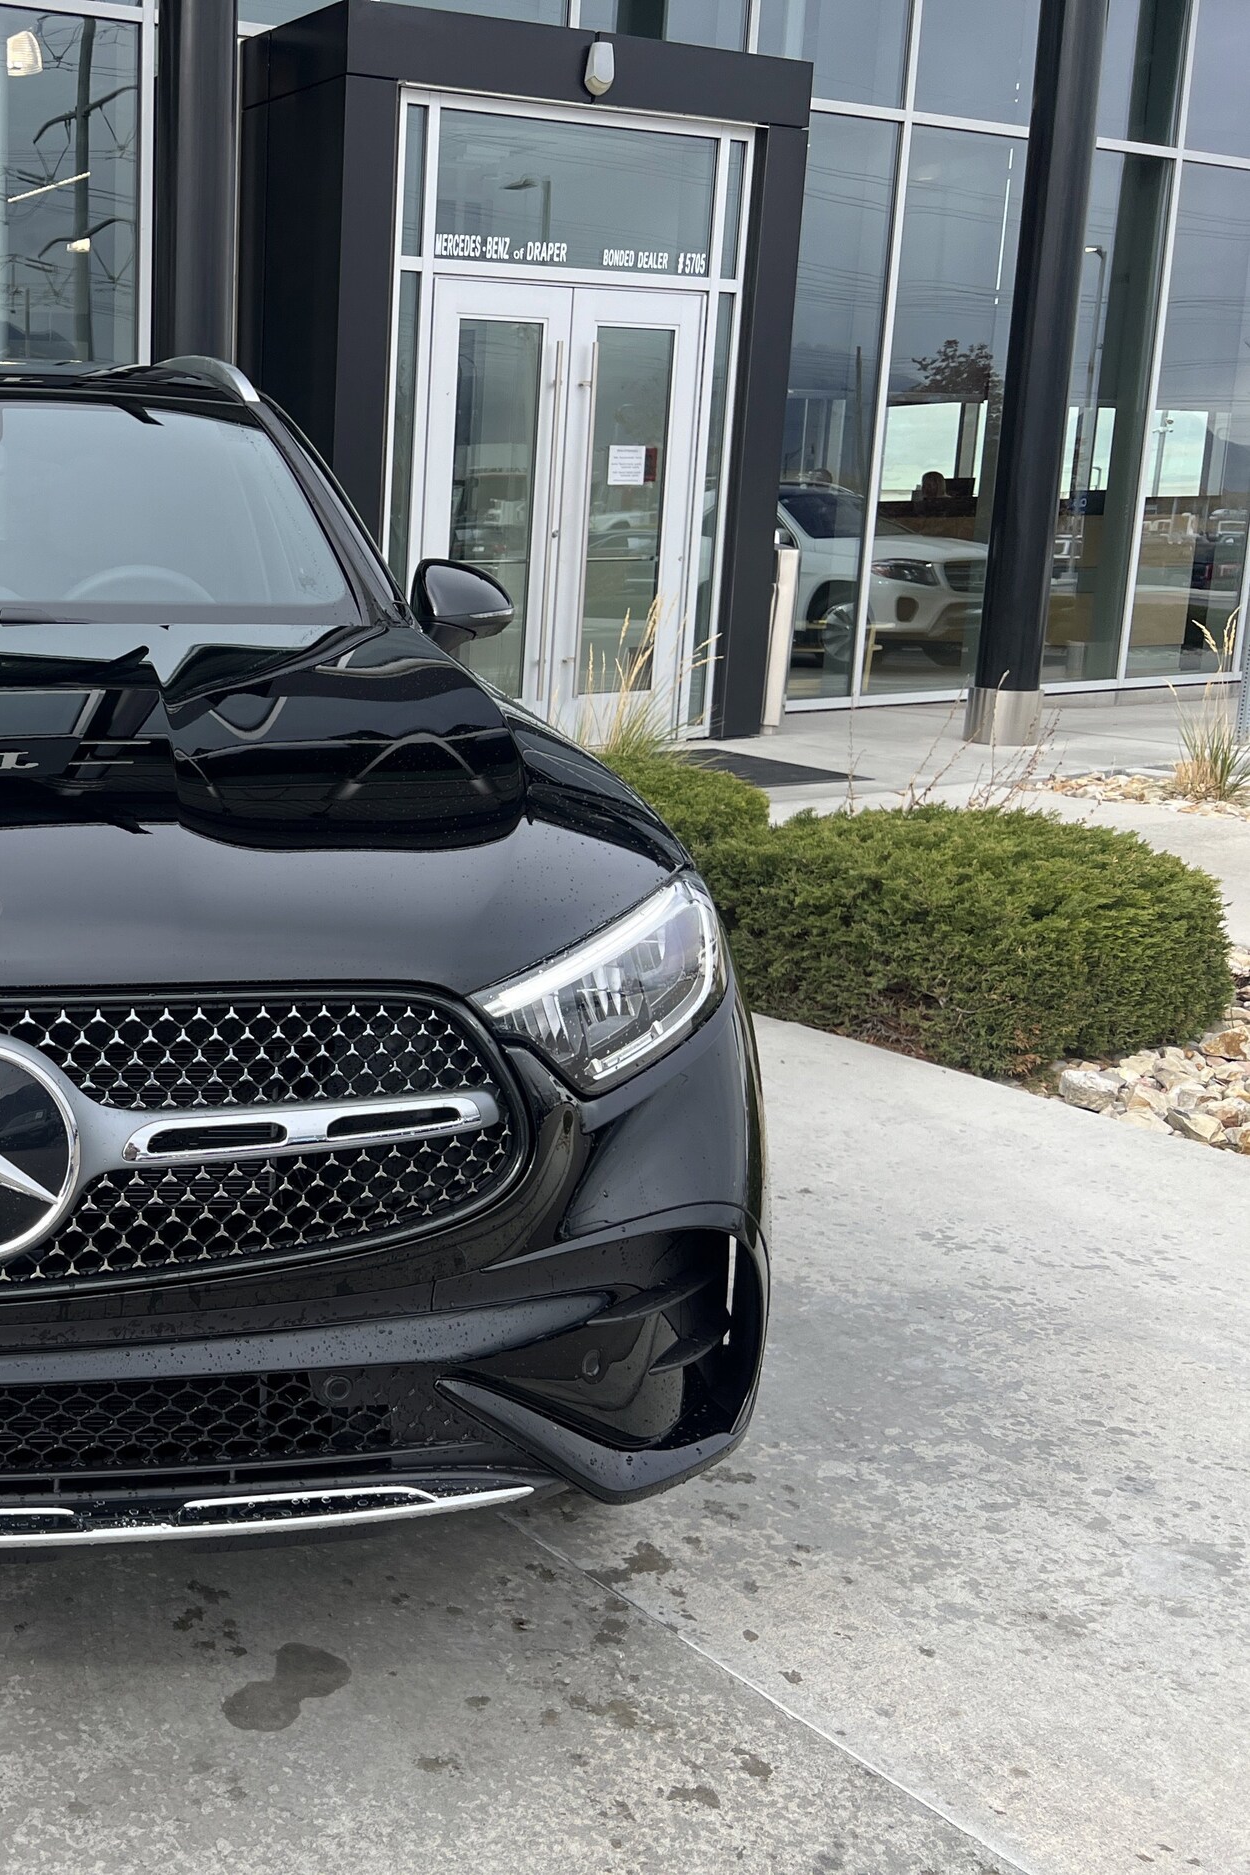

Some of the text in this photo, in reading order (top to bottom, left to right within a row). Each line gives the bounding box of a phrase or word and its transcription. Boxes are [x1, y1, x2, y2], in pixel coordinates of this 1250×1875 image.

[513, 247, 525, 260] of
[526, 241, 568, 262] DRAPER
[602, 248, 635, 267] BONDED
[637, 251, 669, 270] DEALER
